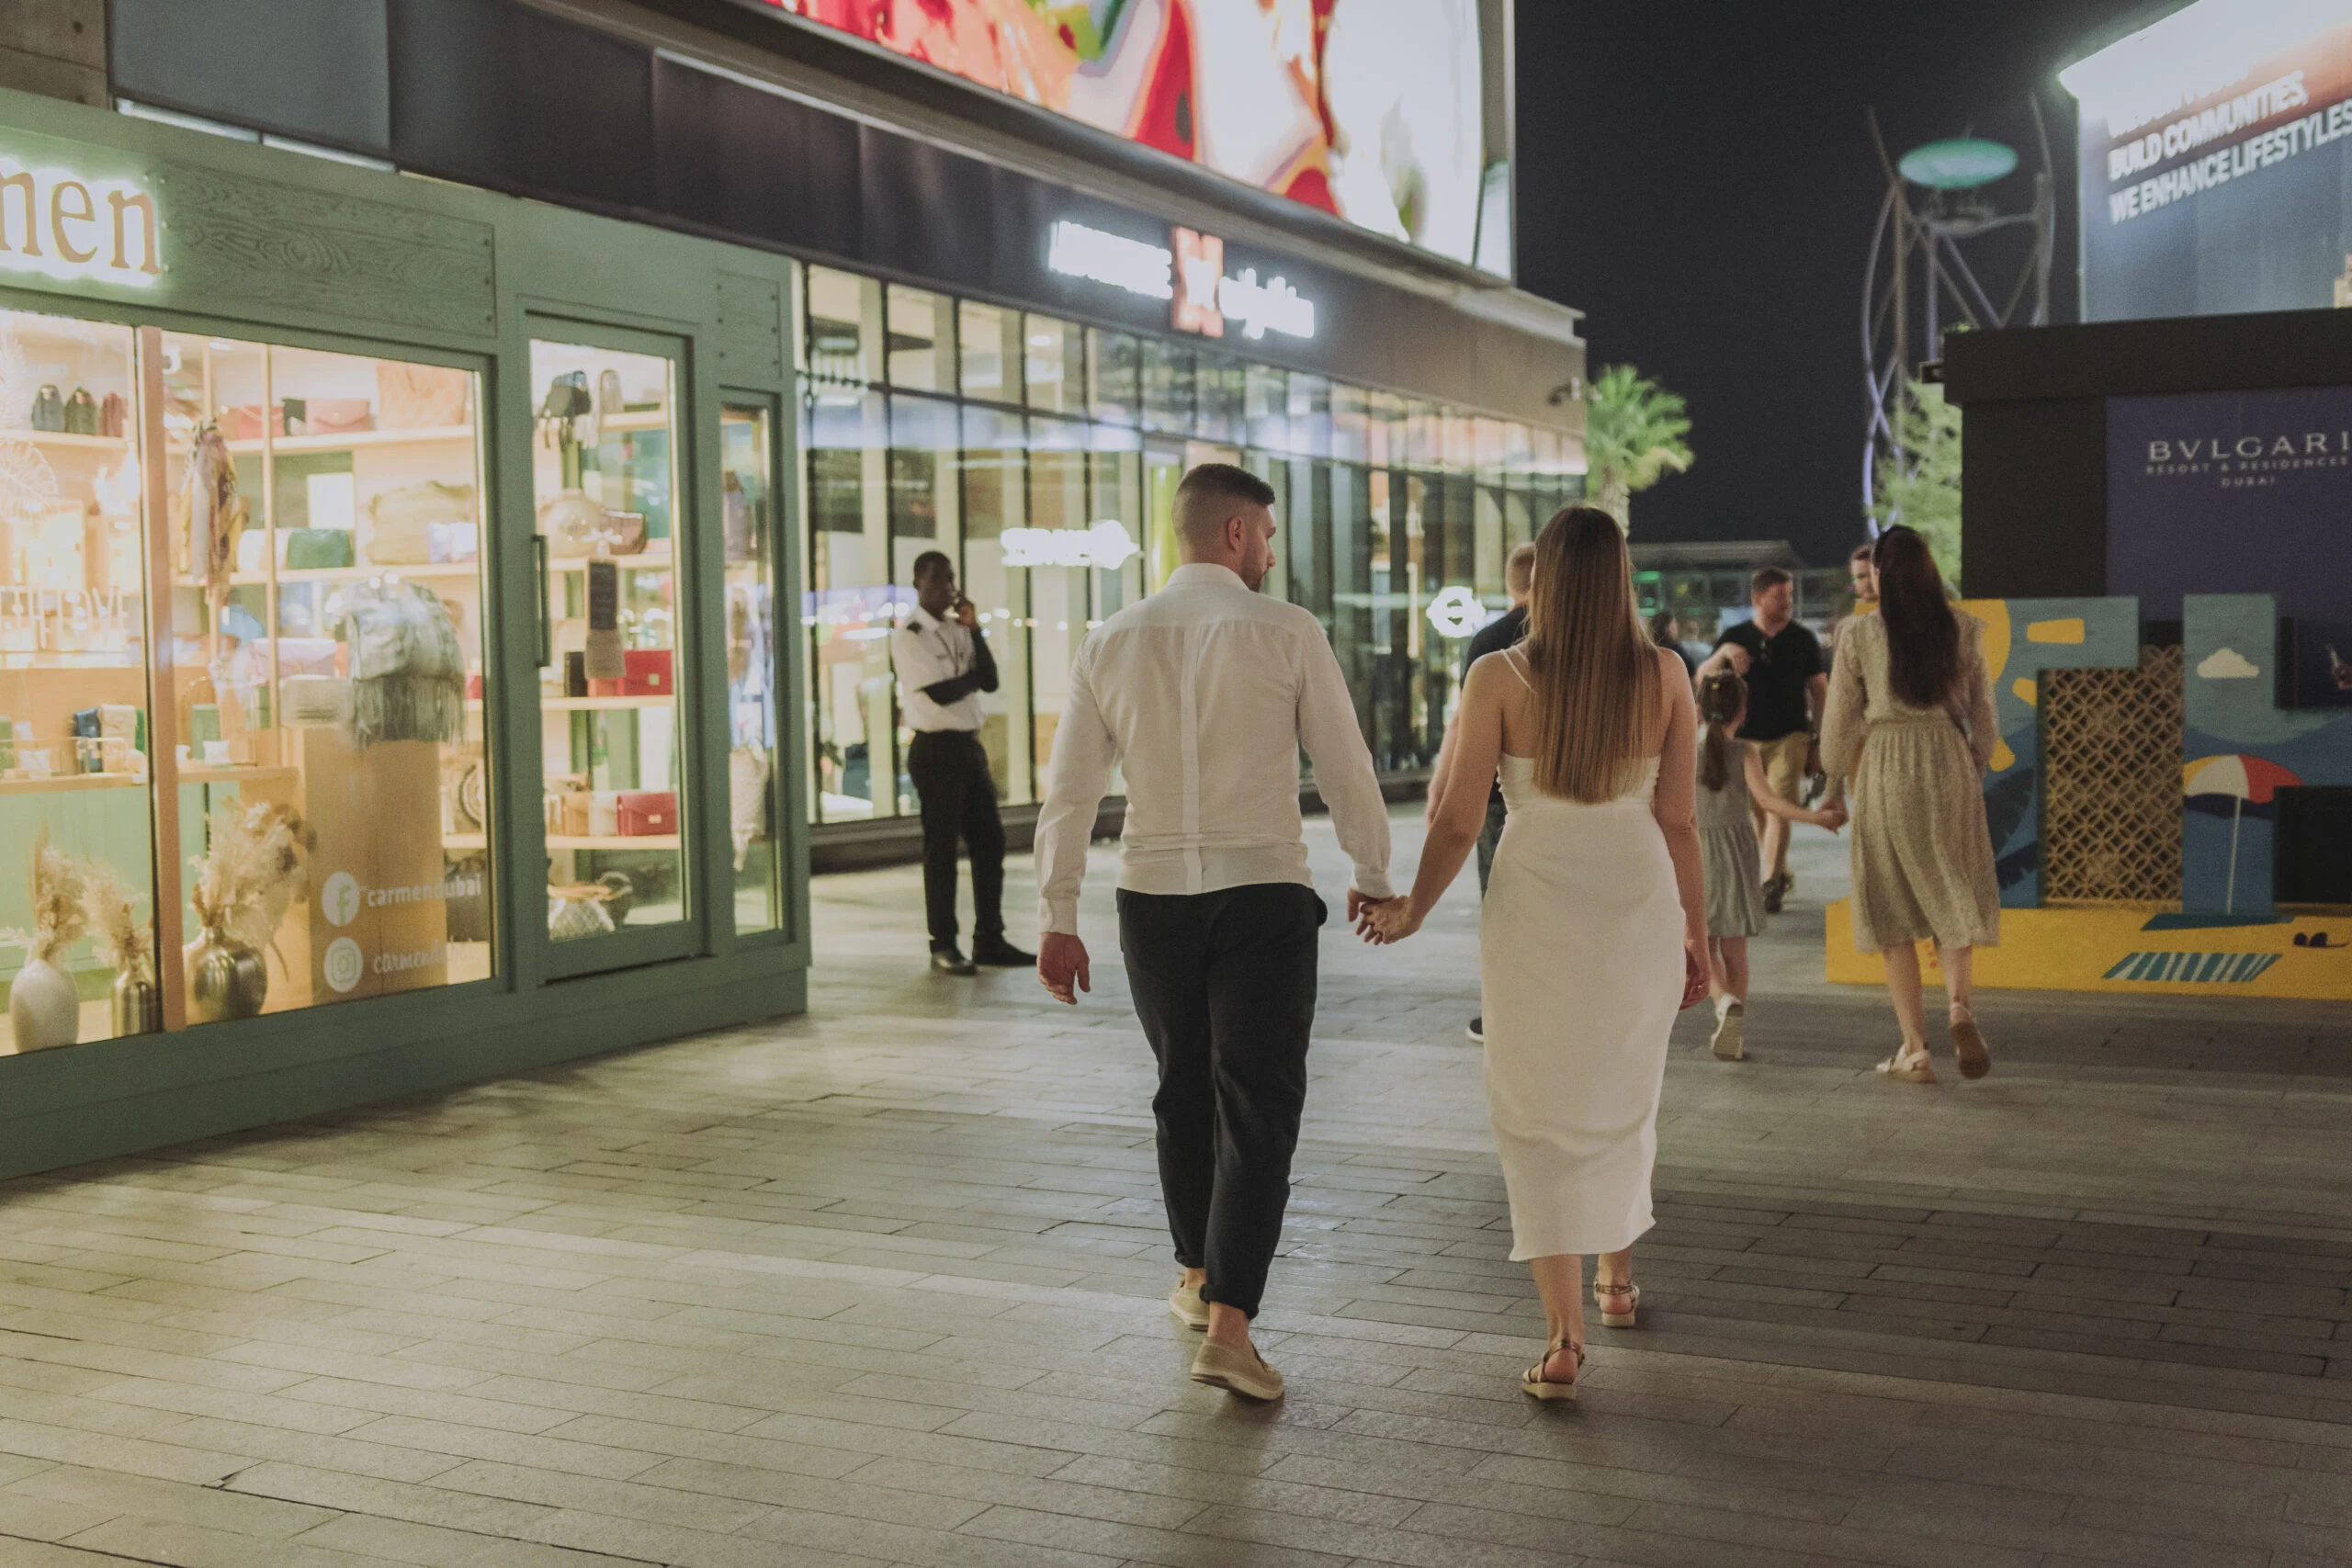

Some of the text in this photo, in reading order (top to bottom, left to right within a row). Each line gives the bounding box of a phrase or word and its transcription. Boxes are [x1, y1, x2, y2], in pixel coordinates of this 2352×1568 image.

[2108, 131, 2162, 181] BUILD
[2109, 186, 2140, 225] WE
[2141, 147, 2231, 213] ENHANCE
[2149, 430, 2349, 462] BVLGARI
[368, 874, 481, 908] carmendubai
